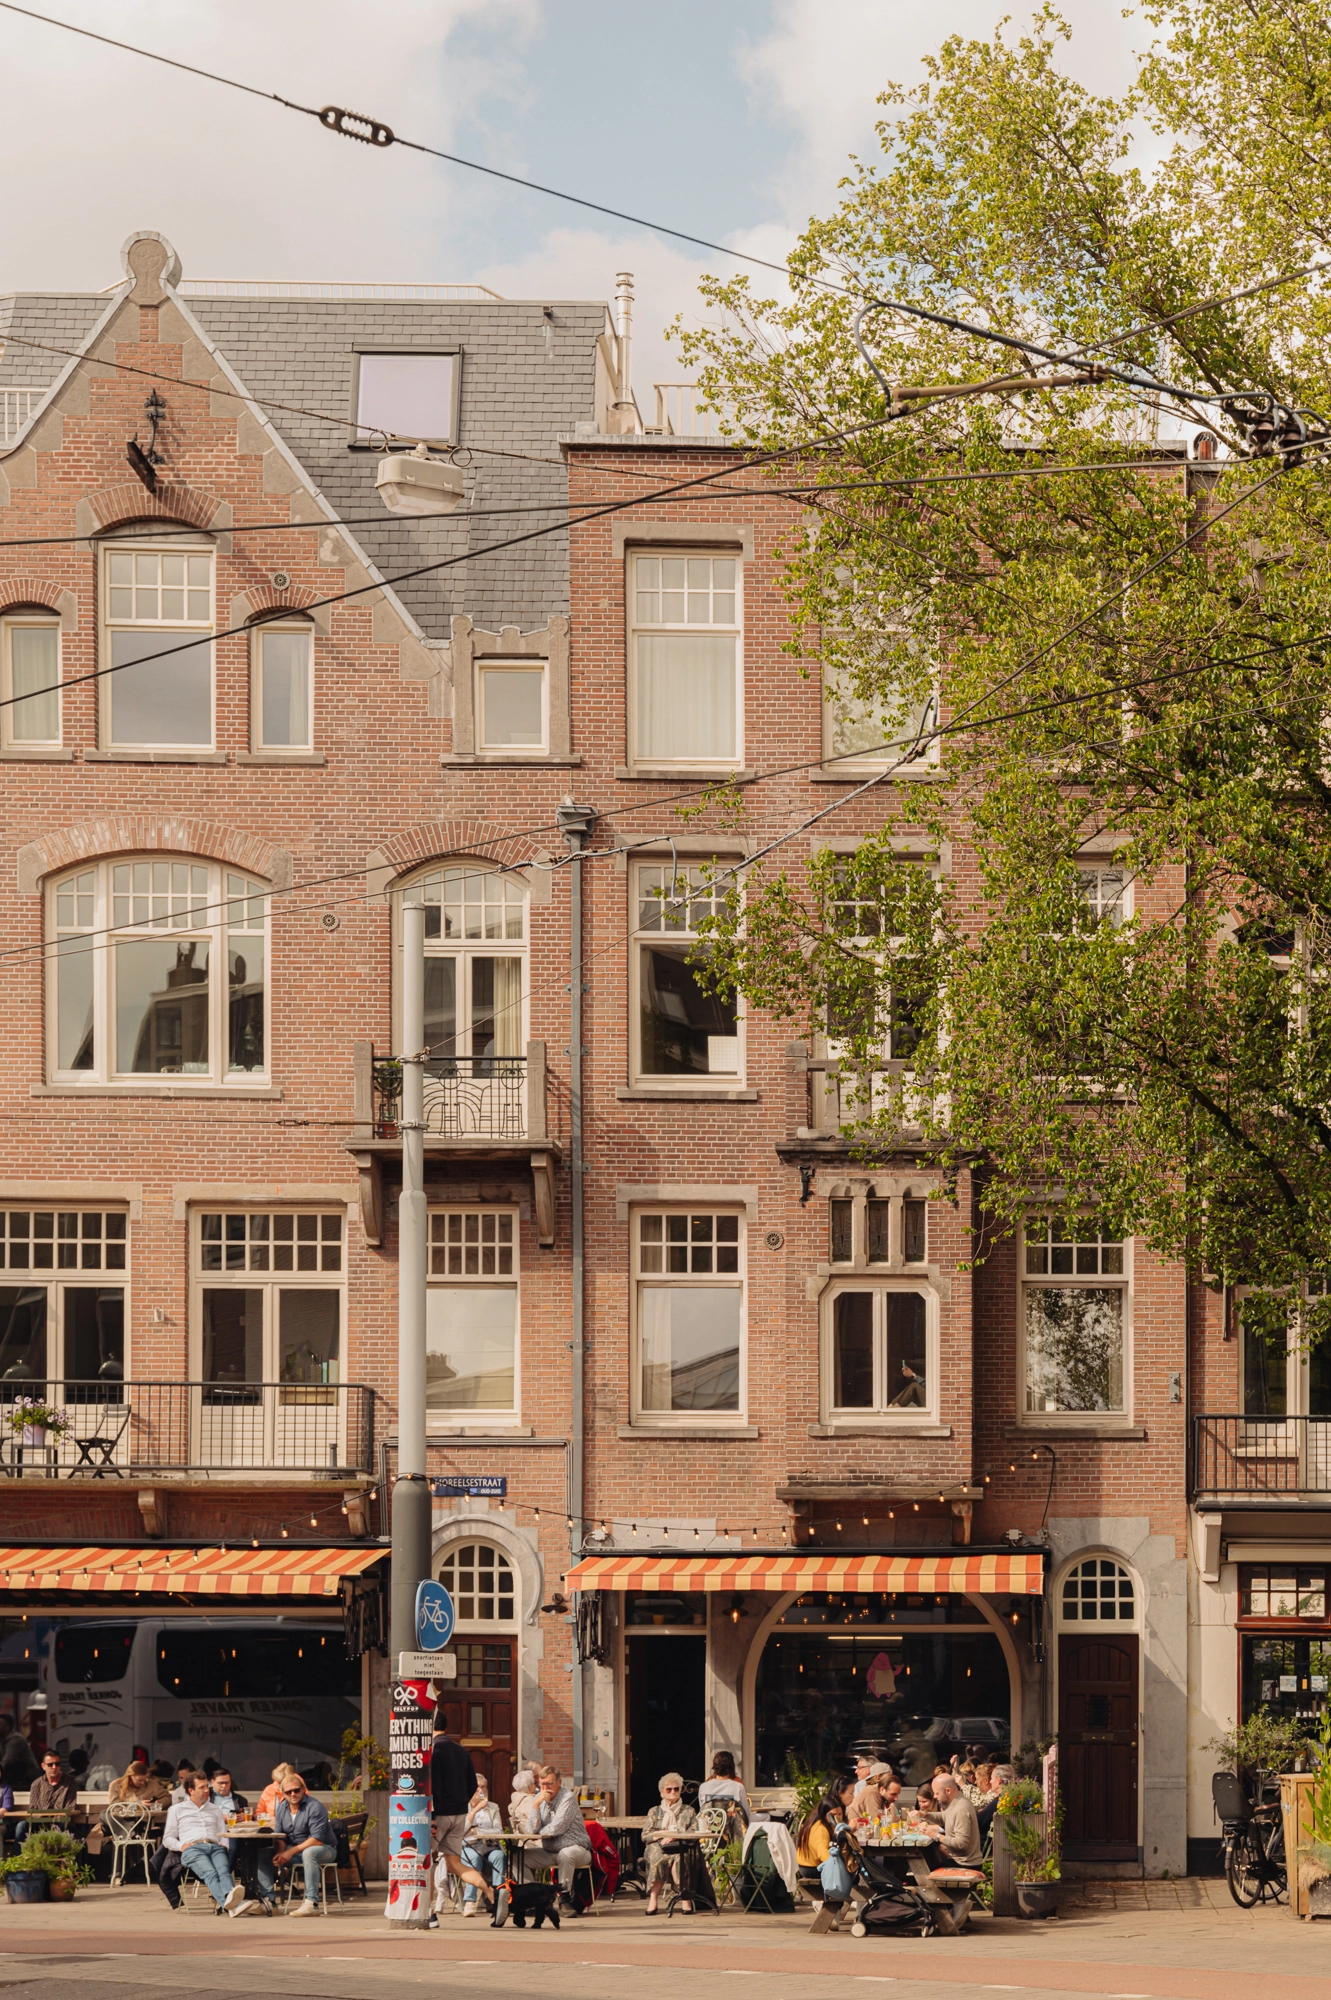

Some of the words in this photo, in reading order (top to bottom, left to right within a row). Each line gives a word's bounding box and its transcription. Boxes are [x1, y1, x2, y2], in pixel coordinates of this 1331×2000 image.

[435, 1478, 502, 1487] MOREELSESTRAAT
[421, 1735, 432, 1751] UP
[391, 1753, 424, 1769] ROSES
